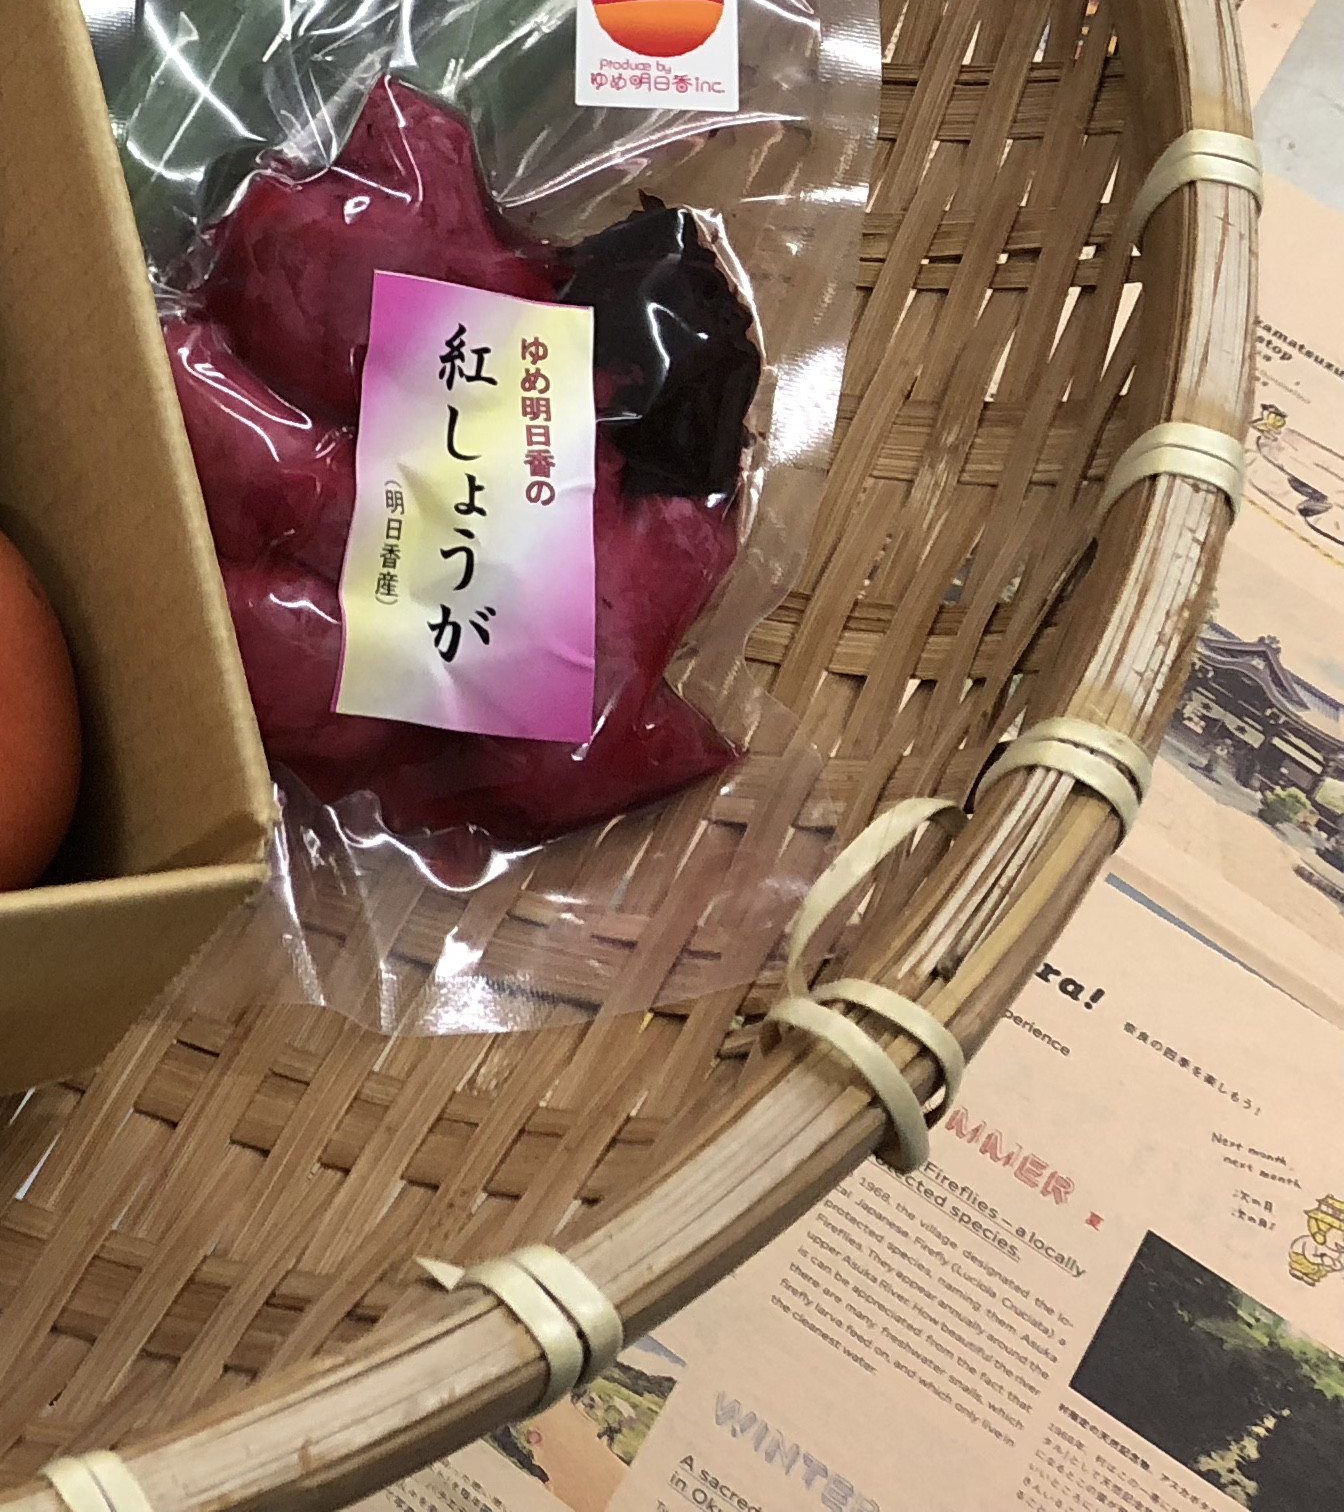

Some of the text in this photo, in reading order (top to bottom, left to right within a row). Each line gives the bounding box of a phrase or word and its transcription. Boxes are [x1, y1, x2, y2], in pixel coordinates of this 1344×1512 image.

[656, 60, 672, 75] by
[518, 337, 558, 506] ゆめ明日香の
[374, 479, 408, 607] （明日香産）
[427, 321, 500, 664] 紅しょうが
[923, 1160, 1087, 1280] Fireflies a locally
[669, 1471, 688, 1491] in
[681, 1454, 696, 1472] A
